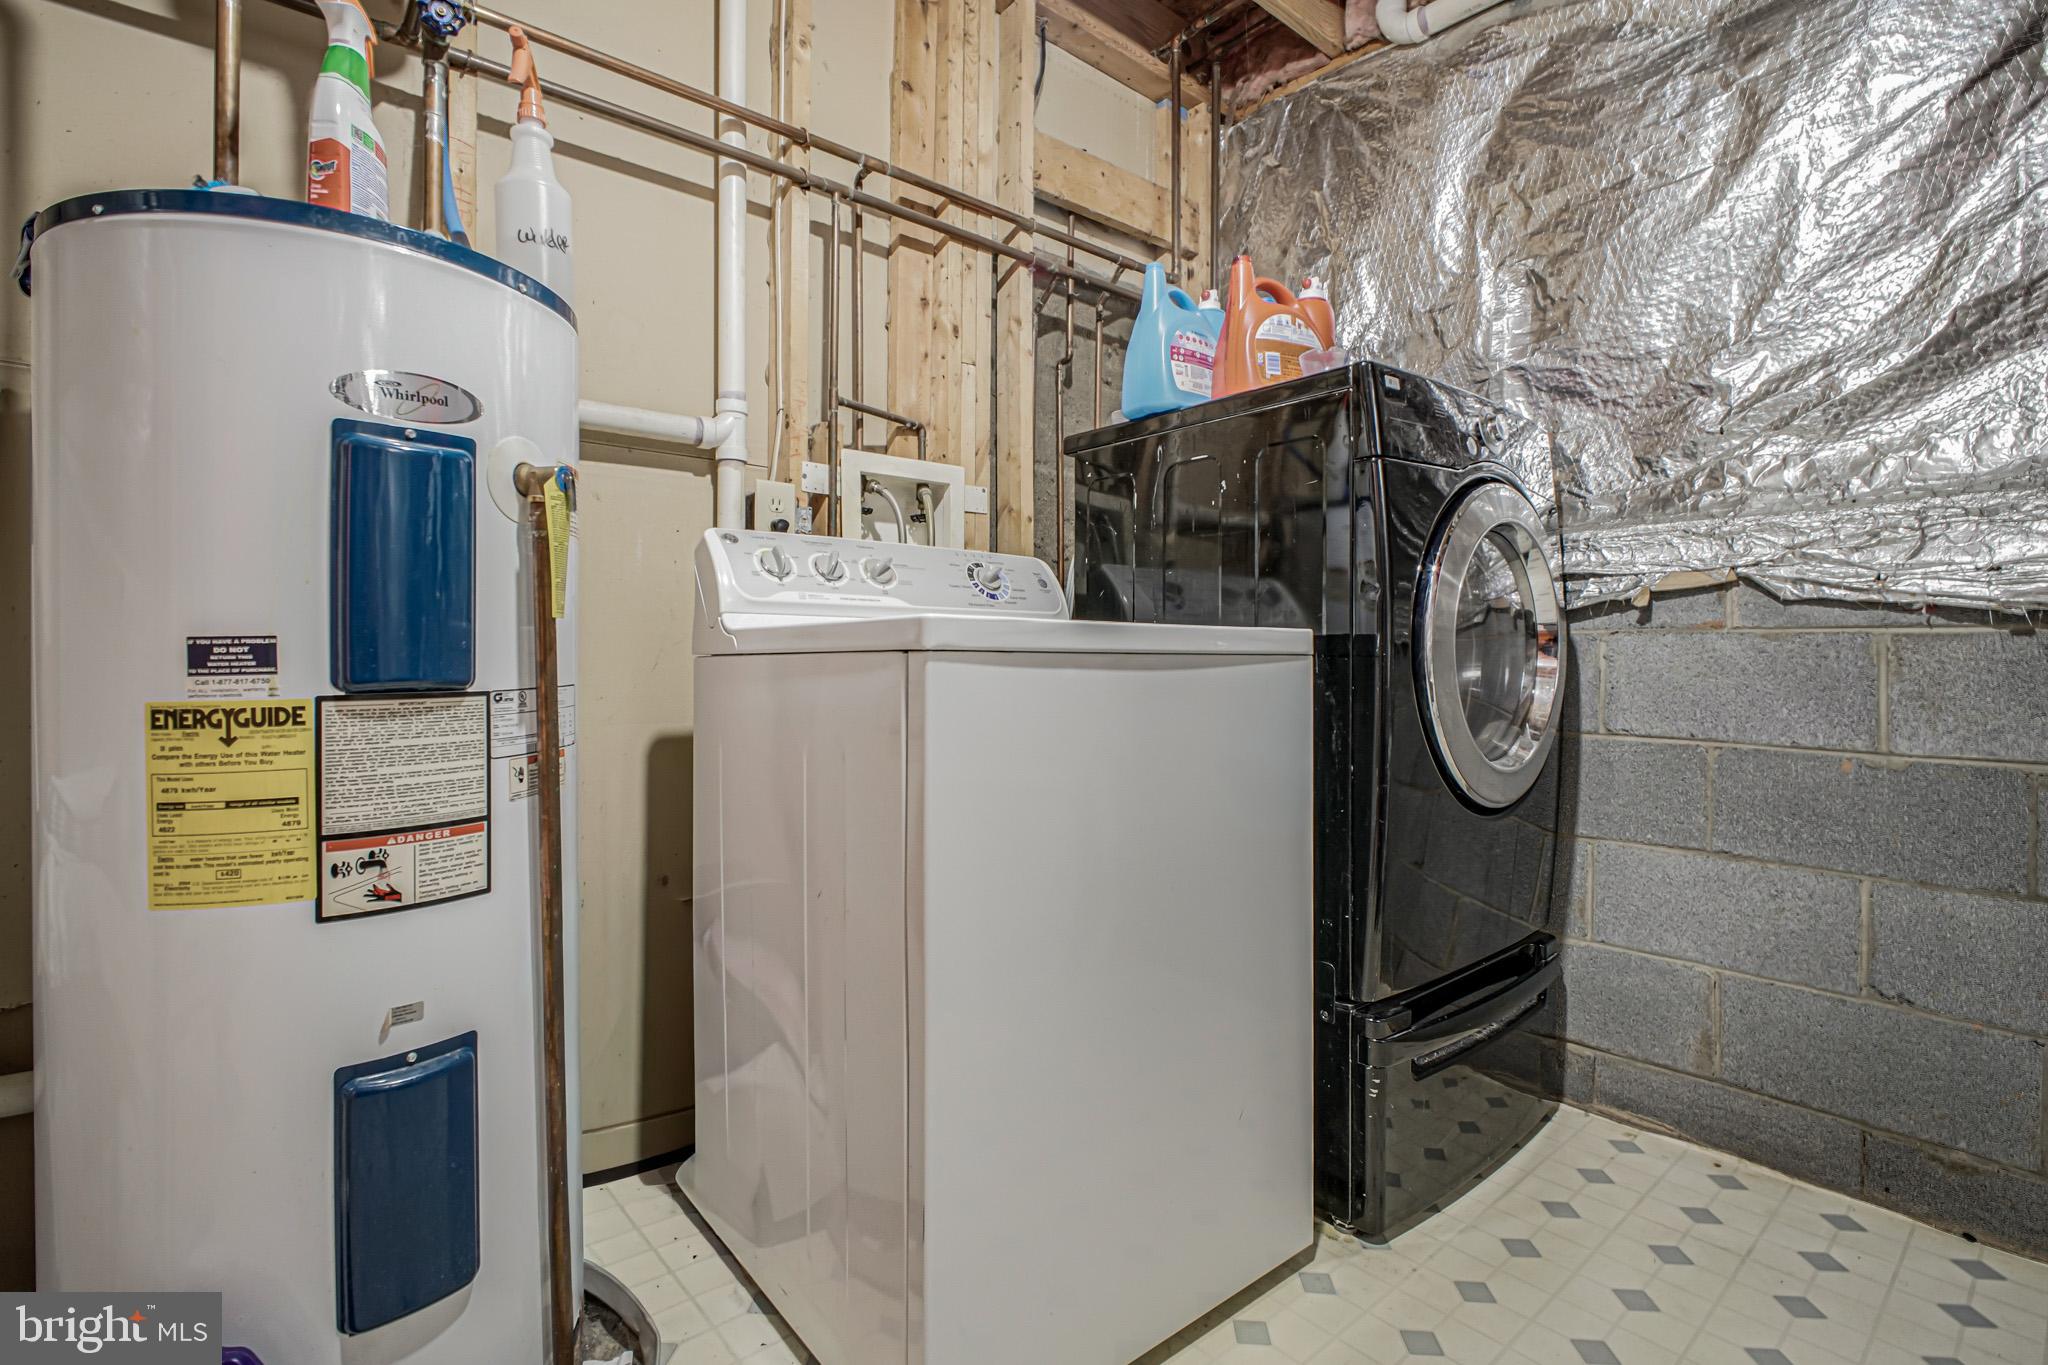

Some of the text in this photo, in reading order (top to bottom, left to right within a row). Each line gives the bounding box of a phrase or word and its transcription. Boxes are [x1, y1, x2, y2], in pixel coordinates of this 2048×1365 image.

[380, 386, 448, 407] Whirlpool
[151, 706, 306, 730] ENERGYGUIDE
[194, 752, 218, 760] Energy
[236, 751, 243, 759] of
[400, 801, 431, 809] CALIFORNIA
[397, 829, 450, 844] DANGER
